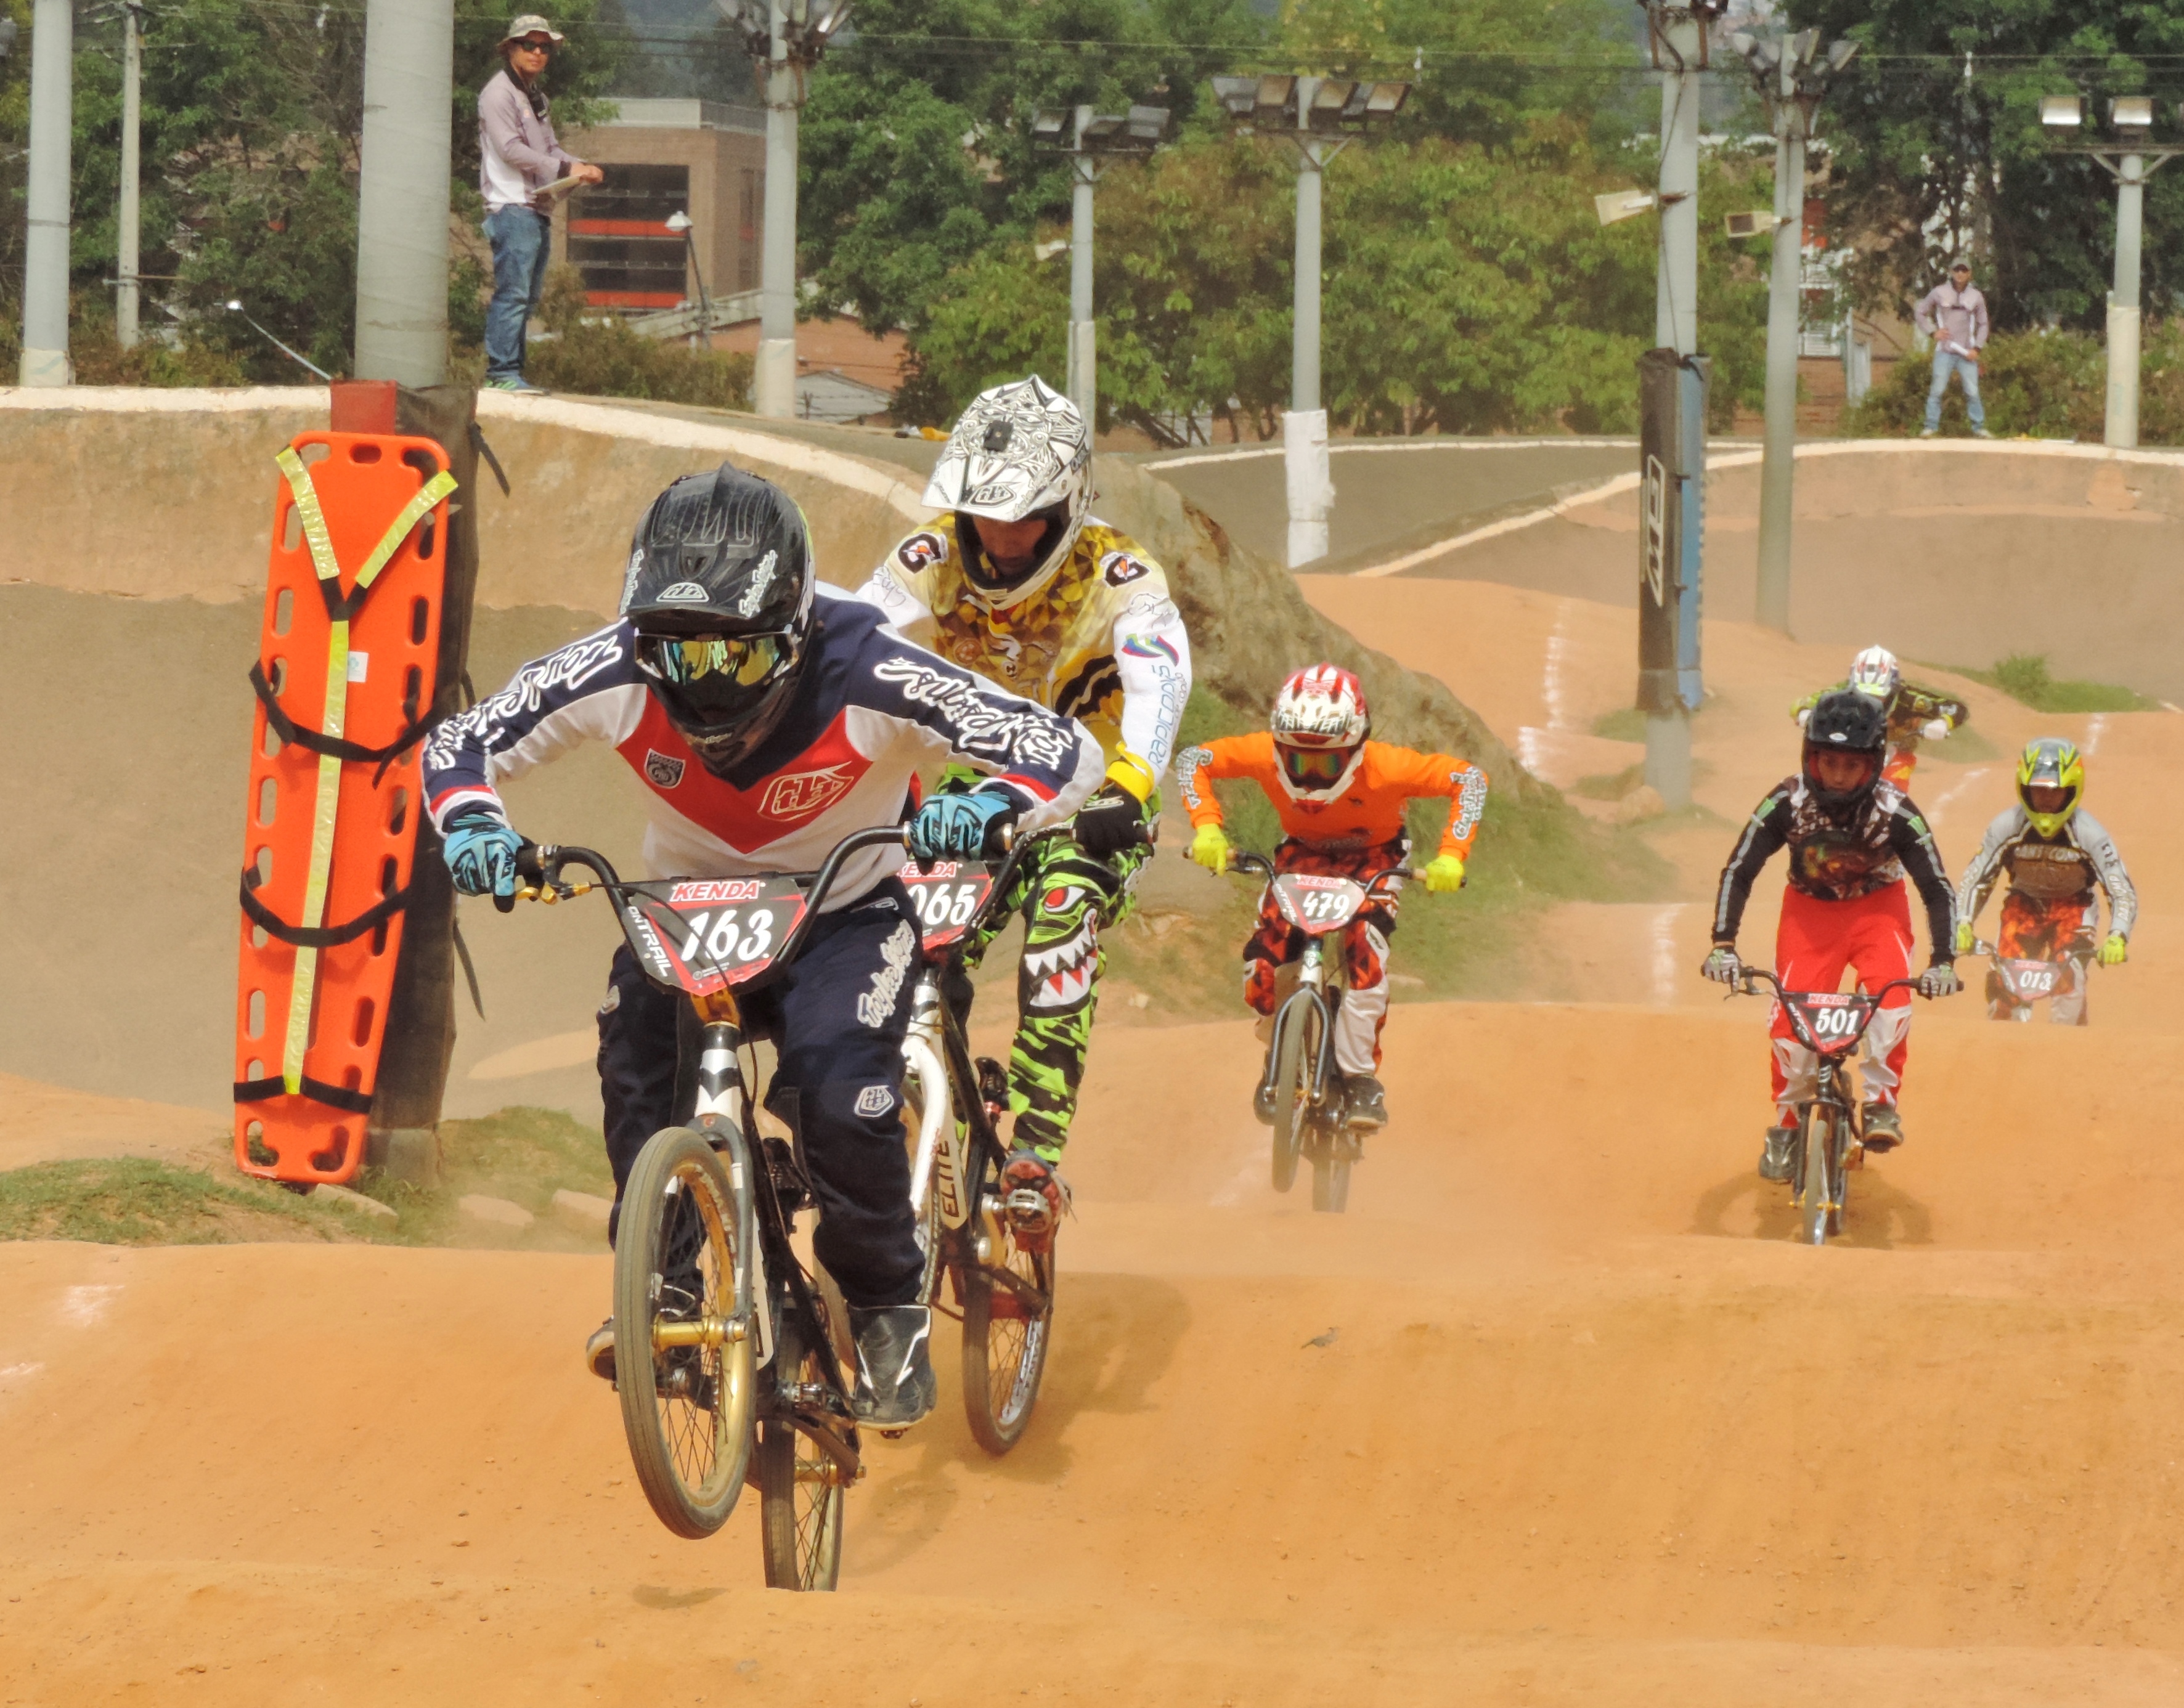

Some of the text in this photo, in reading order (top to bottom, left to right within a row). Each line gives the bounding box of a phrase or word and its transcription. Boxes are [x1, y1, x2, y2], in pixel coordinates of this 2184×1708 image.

[670, 880, 760, 902] KENDA
[1297, 876, 1342, 889] KENDA
[1302, 891, 1350, 919] 479
[680, 909, 773, 961] 163
[2019, 970, 2052, 991] 013
[1815, 1008, 1859, 1035] 501
[937, 1141, 960, 1218] ELITE
